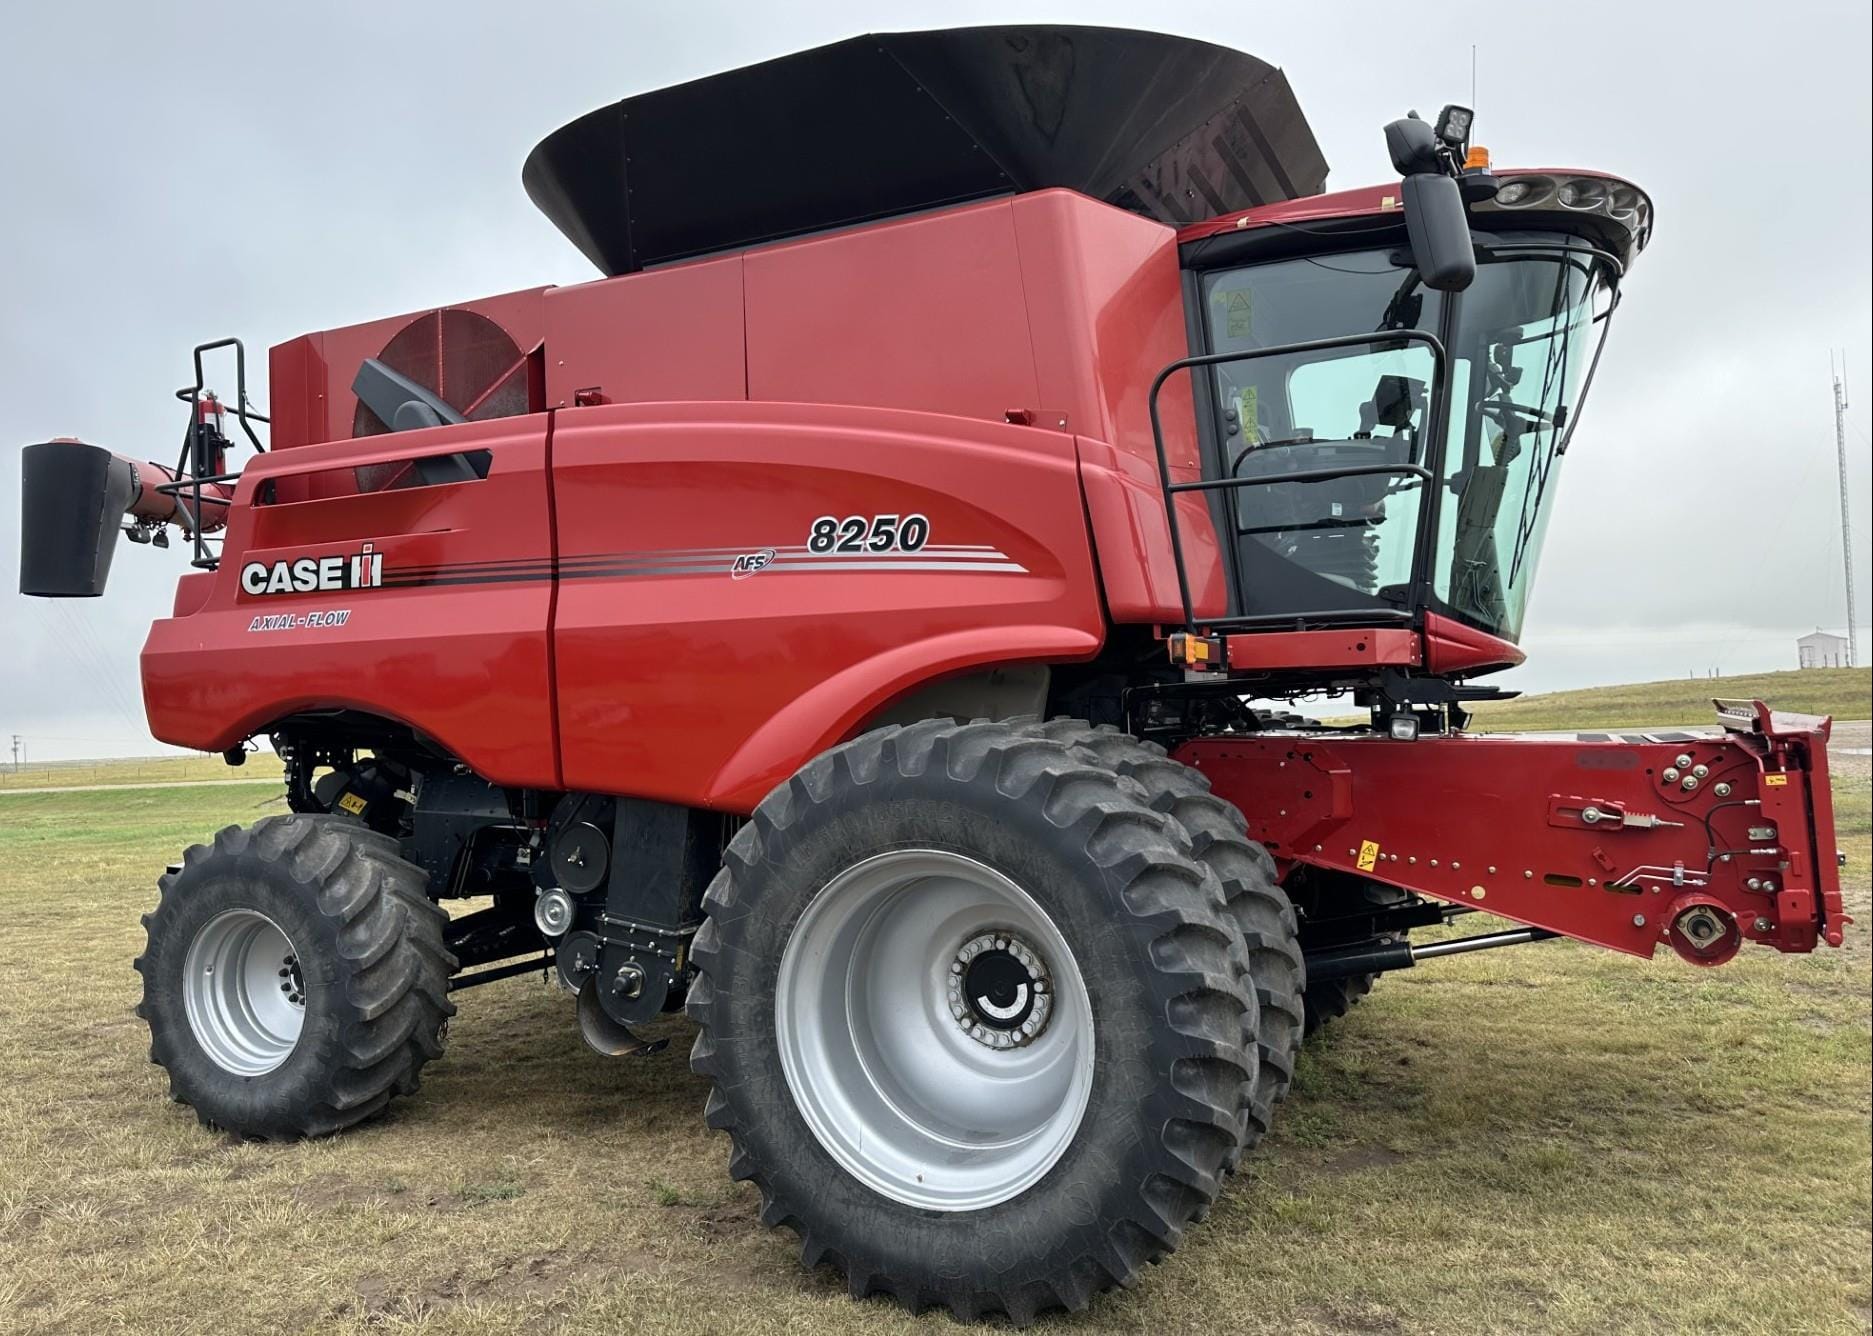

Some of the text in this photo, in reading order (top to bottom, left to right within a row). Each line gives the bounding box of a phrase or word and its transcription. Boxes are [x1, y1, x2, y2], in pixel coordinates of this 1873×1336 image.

[807, 514, 930, 554] 8250
[241, 556, 345, 595] CASE
[733, 555, 766, 572] AFS
[248, 610, 351, 632] AXIAL-FLOW
